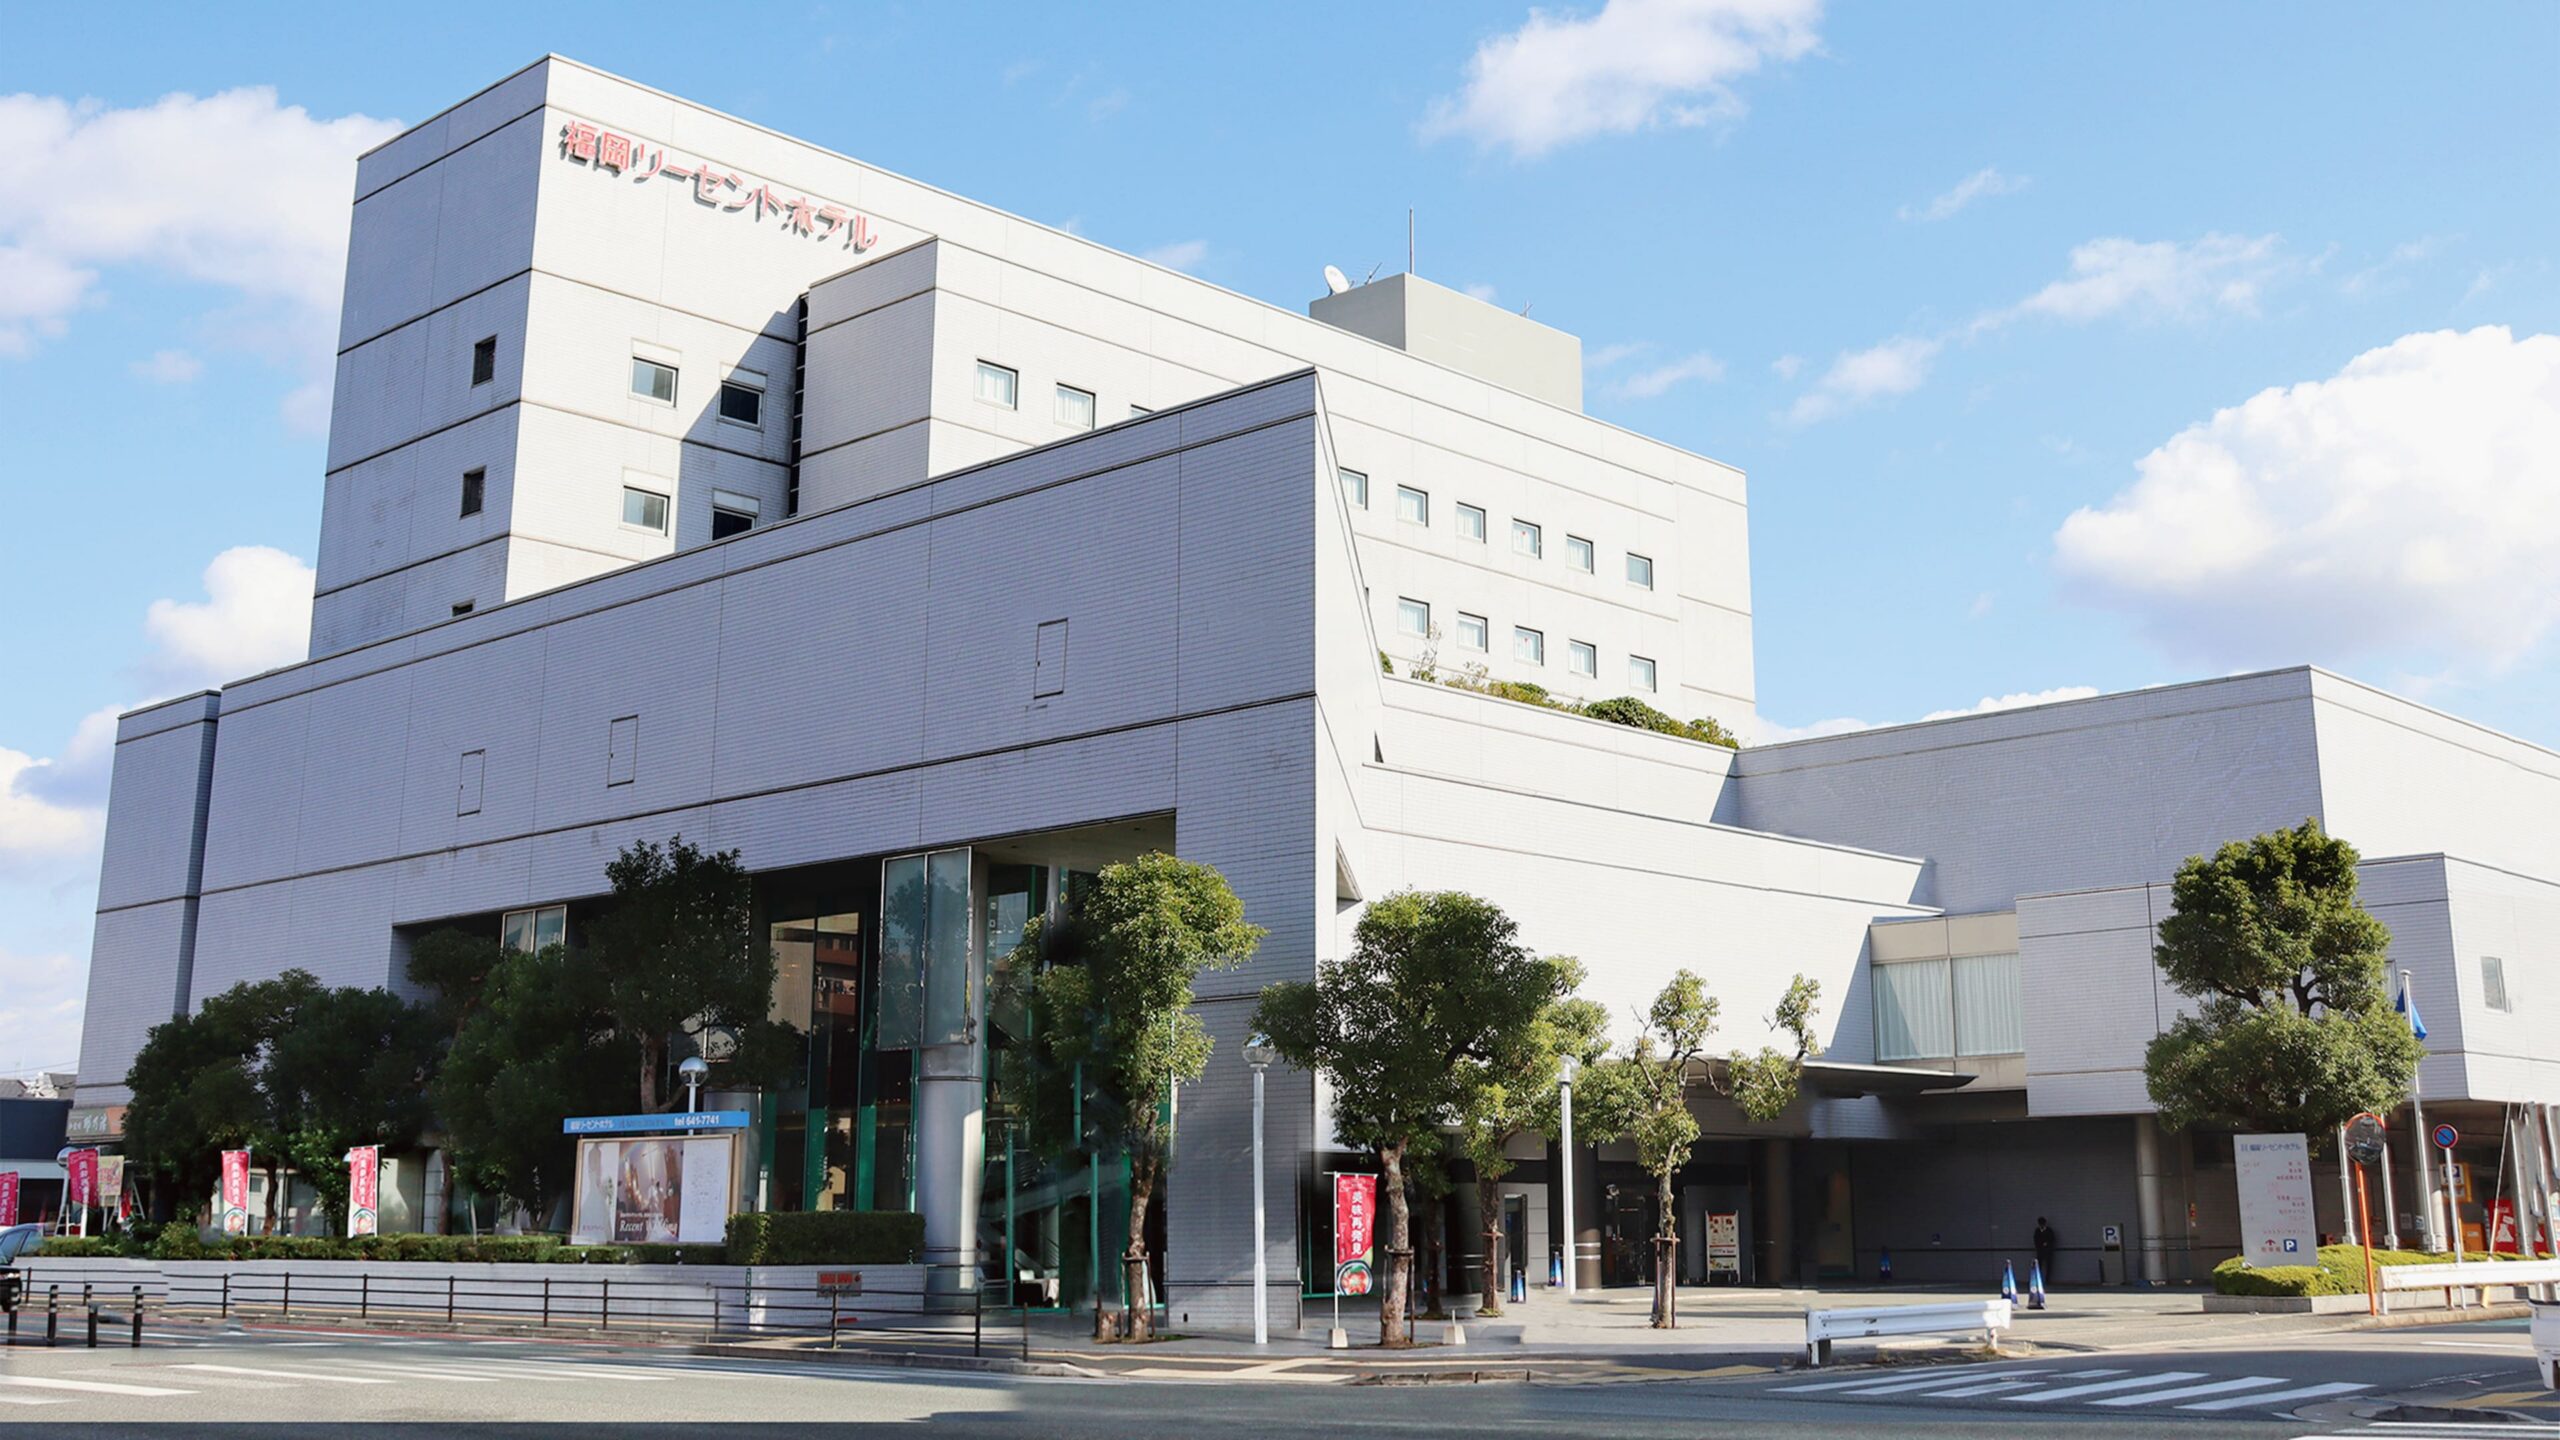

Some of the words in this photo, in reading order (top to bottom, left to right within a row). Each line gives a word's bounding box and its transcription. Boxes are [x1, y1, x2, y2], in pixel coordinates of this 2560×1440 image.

[563, 119, 877, 250] 福岡リーセントホテル
[674, 1116, 685, 1127] tel
[686, 1114, 720, 1127] 641-7741
[1351, 1191, 1364, 1255] 美味再発見
[2105, 1227, 2116, 1241] P
[2285, 1240, 2296, 1252] P
